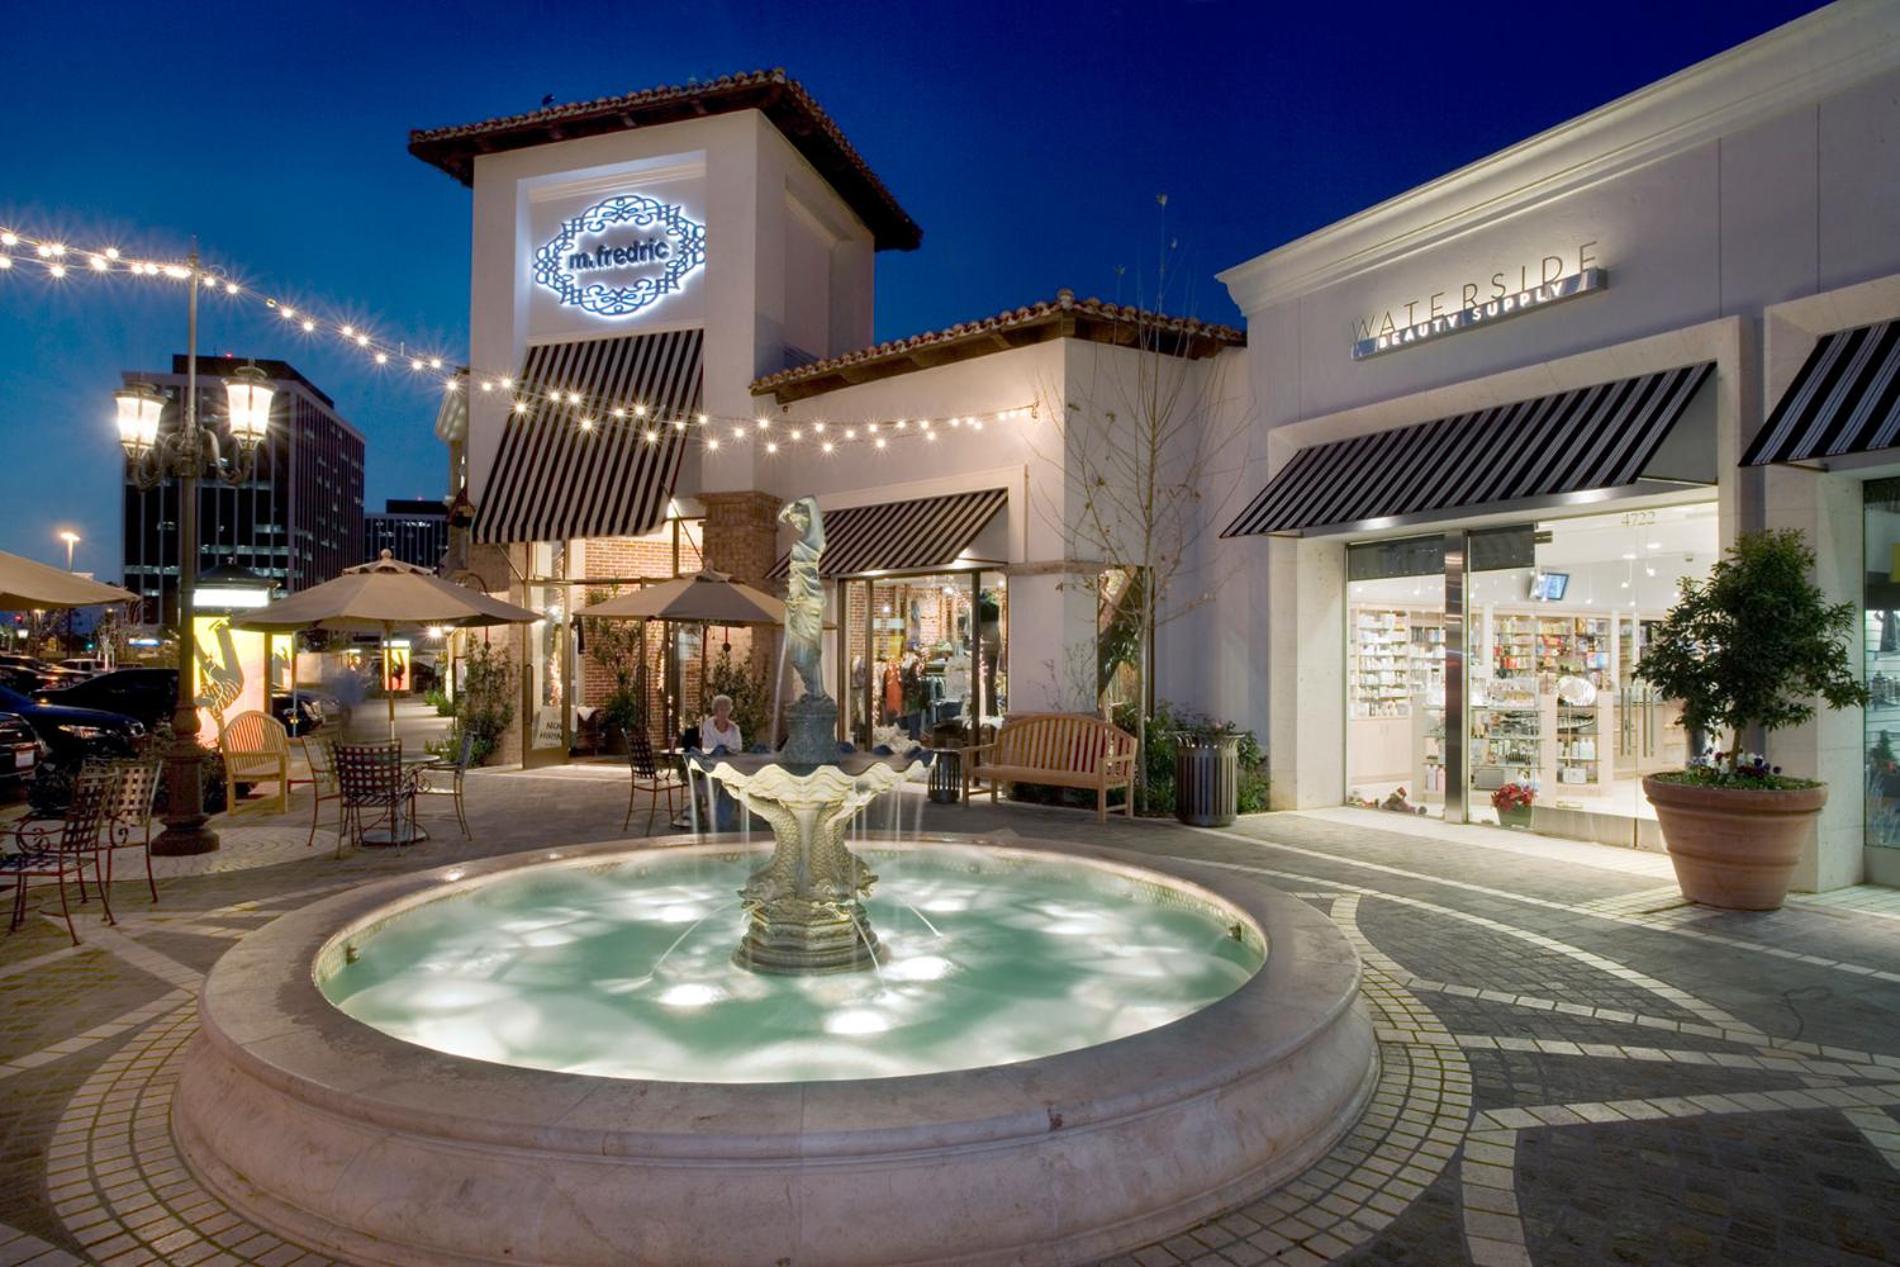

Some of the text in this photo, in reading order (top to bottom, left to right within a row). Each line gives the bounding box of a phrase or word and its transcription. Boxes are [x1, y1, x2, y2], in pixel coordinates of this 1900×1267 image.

[569, 238, 669, 269] m.fredric
[1351, 241, 1597, 340] WATERSIDE
[1378, 283, 1564, 349] BEAUTY SUPPLY
